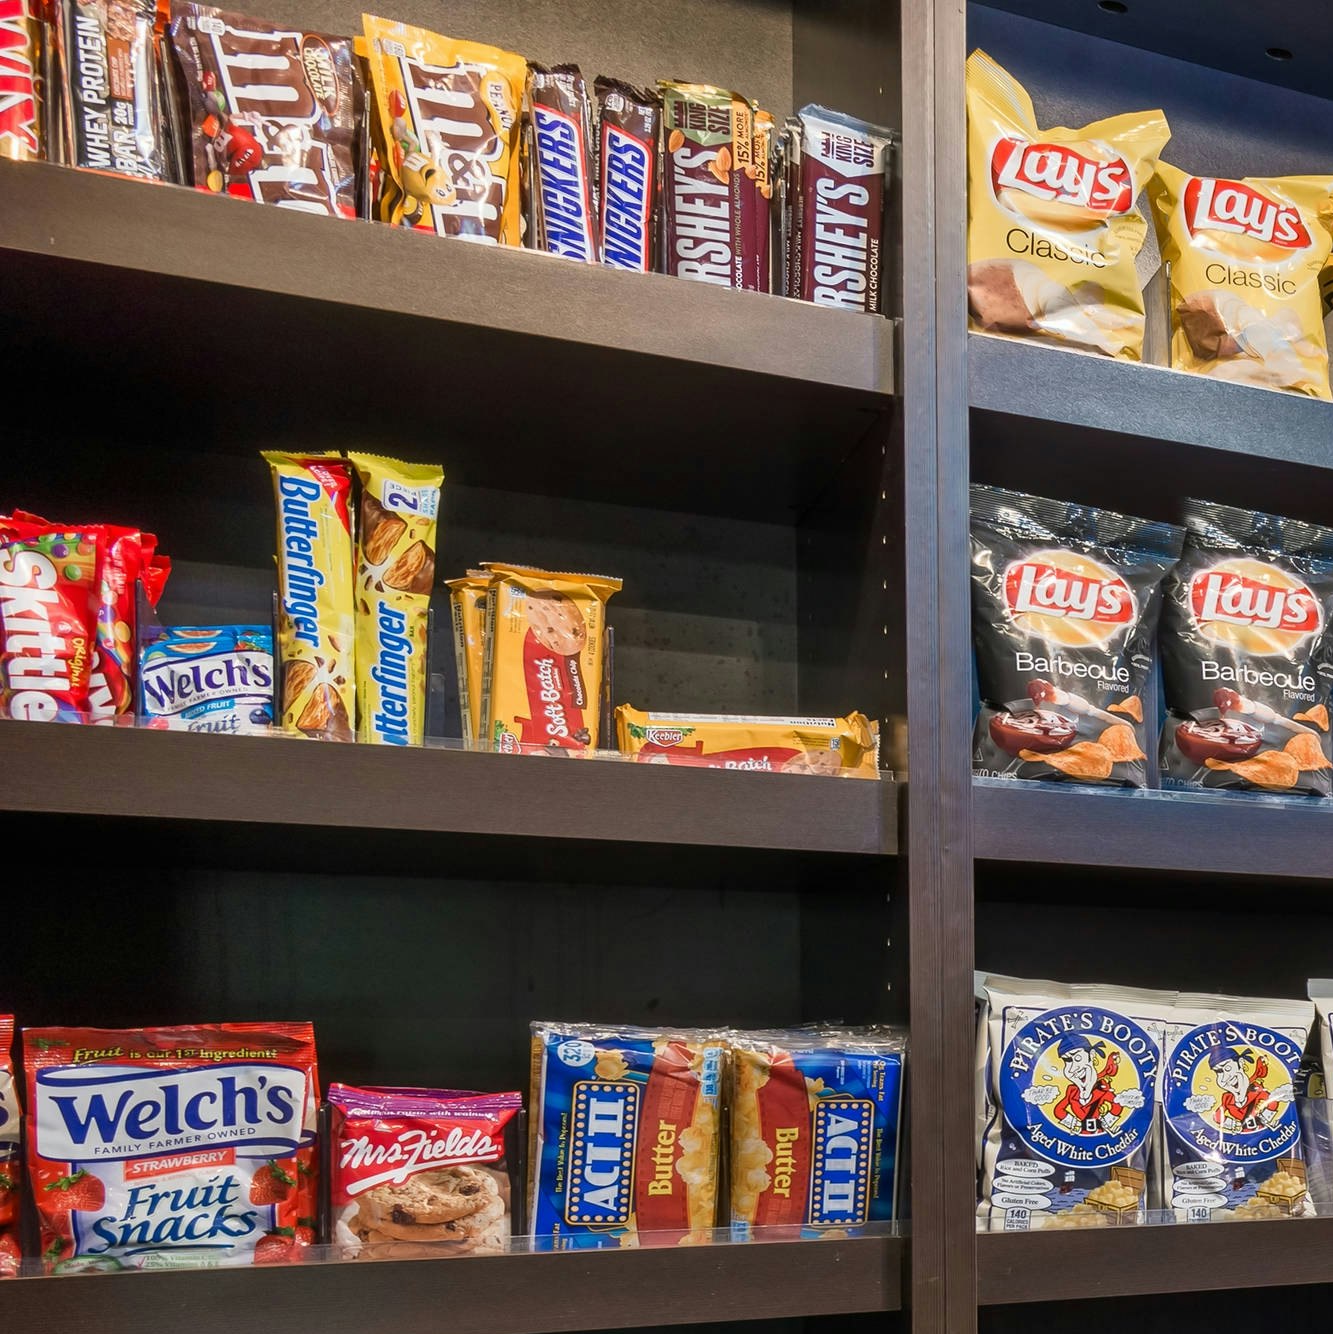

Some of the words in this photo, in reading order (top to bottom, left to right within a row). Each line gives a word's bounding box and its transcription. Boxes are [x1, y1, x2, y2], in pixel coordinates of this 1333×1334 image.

[76, 16, 106, 105] PROTEIN
[85, 104, 111, 168] WHEY
[998, 141, 1124, 211] Lay's
[1196, 179, 1299, 242] Lay's
[814, 177, 870, 312] RSHEY'S
[870, 238, 879, 287] CHOCOLATE
[1005, 228, 1106, 268] Classic
[869, 289, 877, 312] MILK
[1205, 264, 1297, 296] Classic
[279, 475, 324, 648] Butterfinger
[1014, 565, 1125, 621] Lay's
[1201, 573, 1311, 629] Lay's
[0, 548, 77, 720] Skittle
[145, 655, 271, 706] Welch's
[1015, 652, 1130, 683] Barbecue
[1097, 680, 1130, 694] Flavored
[1201, 661, 1316, 691] Barbecue
[1282, 689, 1316, 703] Flavored
[1011, 1012, 1093, 1071] PIRATE'S
[1100, 1017, 1158, 1078] BOOTY
[49, 1076, 294, 1144] Welch's
[588, 1098, 624, 1137] II
[94, 1144, 141, 1155] FAMILY
[149, 1135, 201, 1149] FARMER
[208, 1128, 256, 1139] OWNED
[132, 1151, 228, 1174] STRAWBERRY
[648, 1119, 677, 1197] Butter
[773, 1127, 800, 1198] Butter
[826, 1113, 859, 1174] ACT
[1027, 1122, 1053, 1150] Aged
[1055, 1139, 1093, 1161] White
[1094, 1128, 1140, 1158] Cheddar
[120, 1175, 240, 1222] Fruit
[584, 1146, 621, 1211] ACT
[822, 1179, 857, 1214] II
[88, 1205, 258, 1253] Snacks
[1010, 1209, 1027, 1219] 140
[1191, 1208, 1207, 1218] 140
